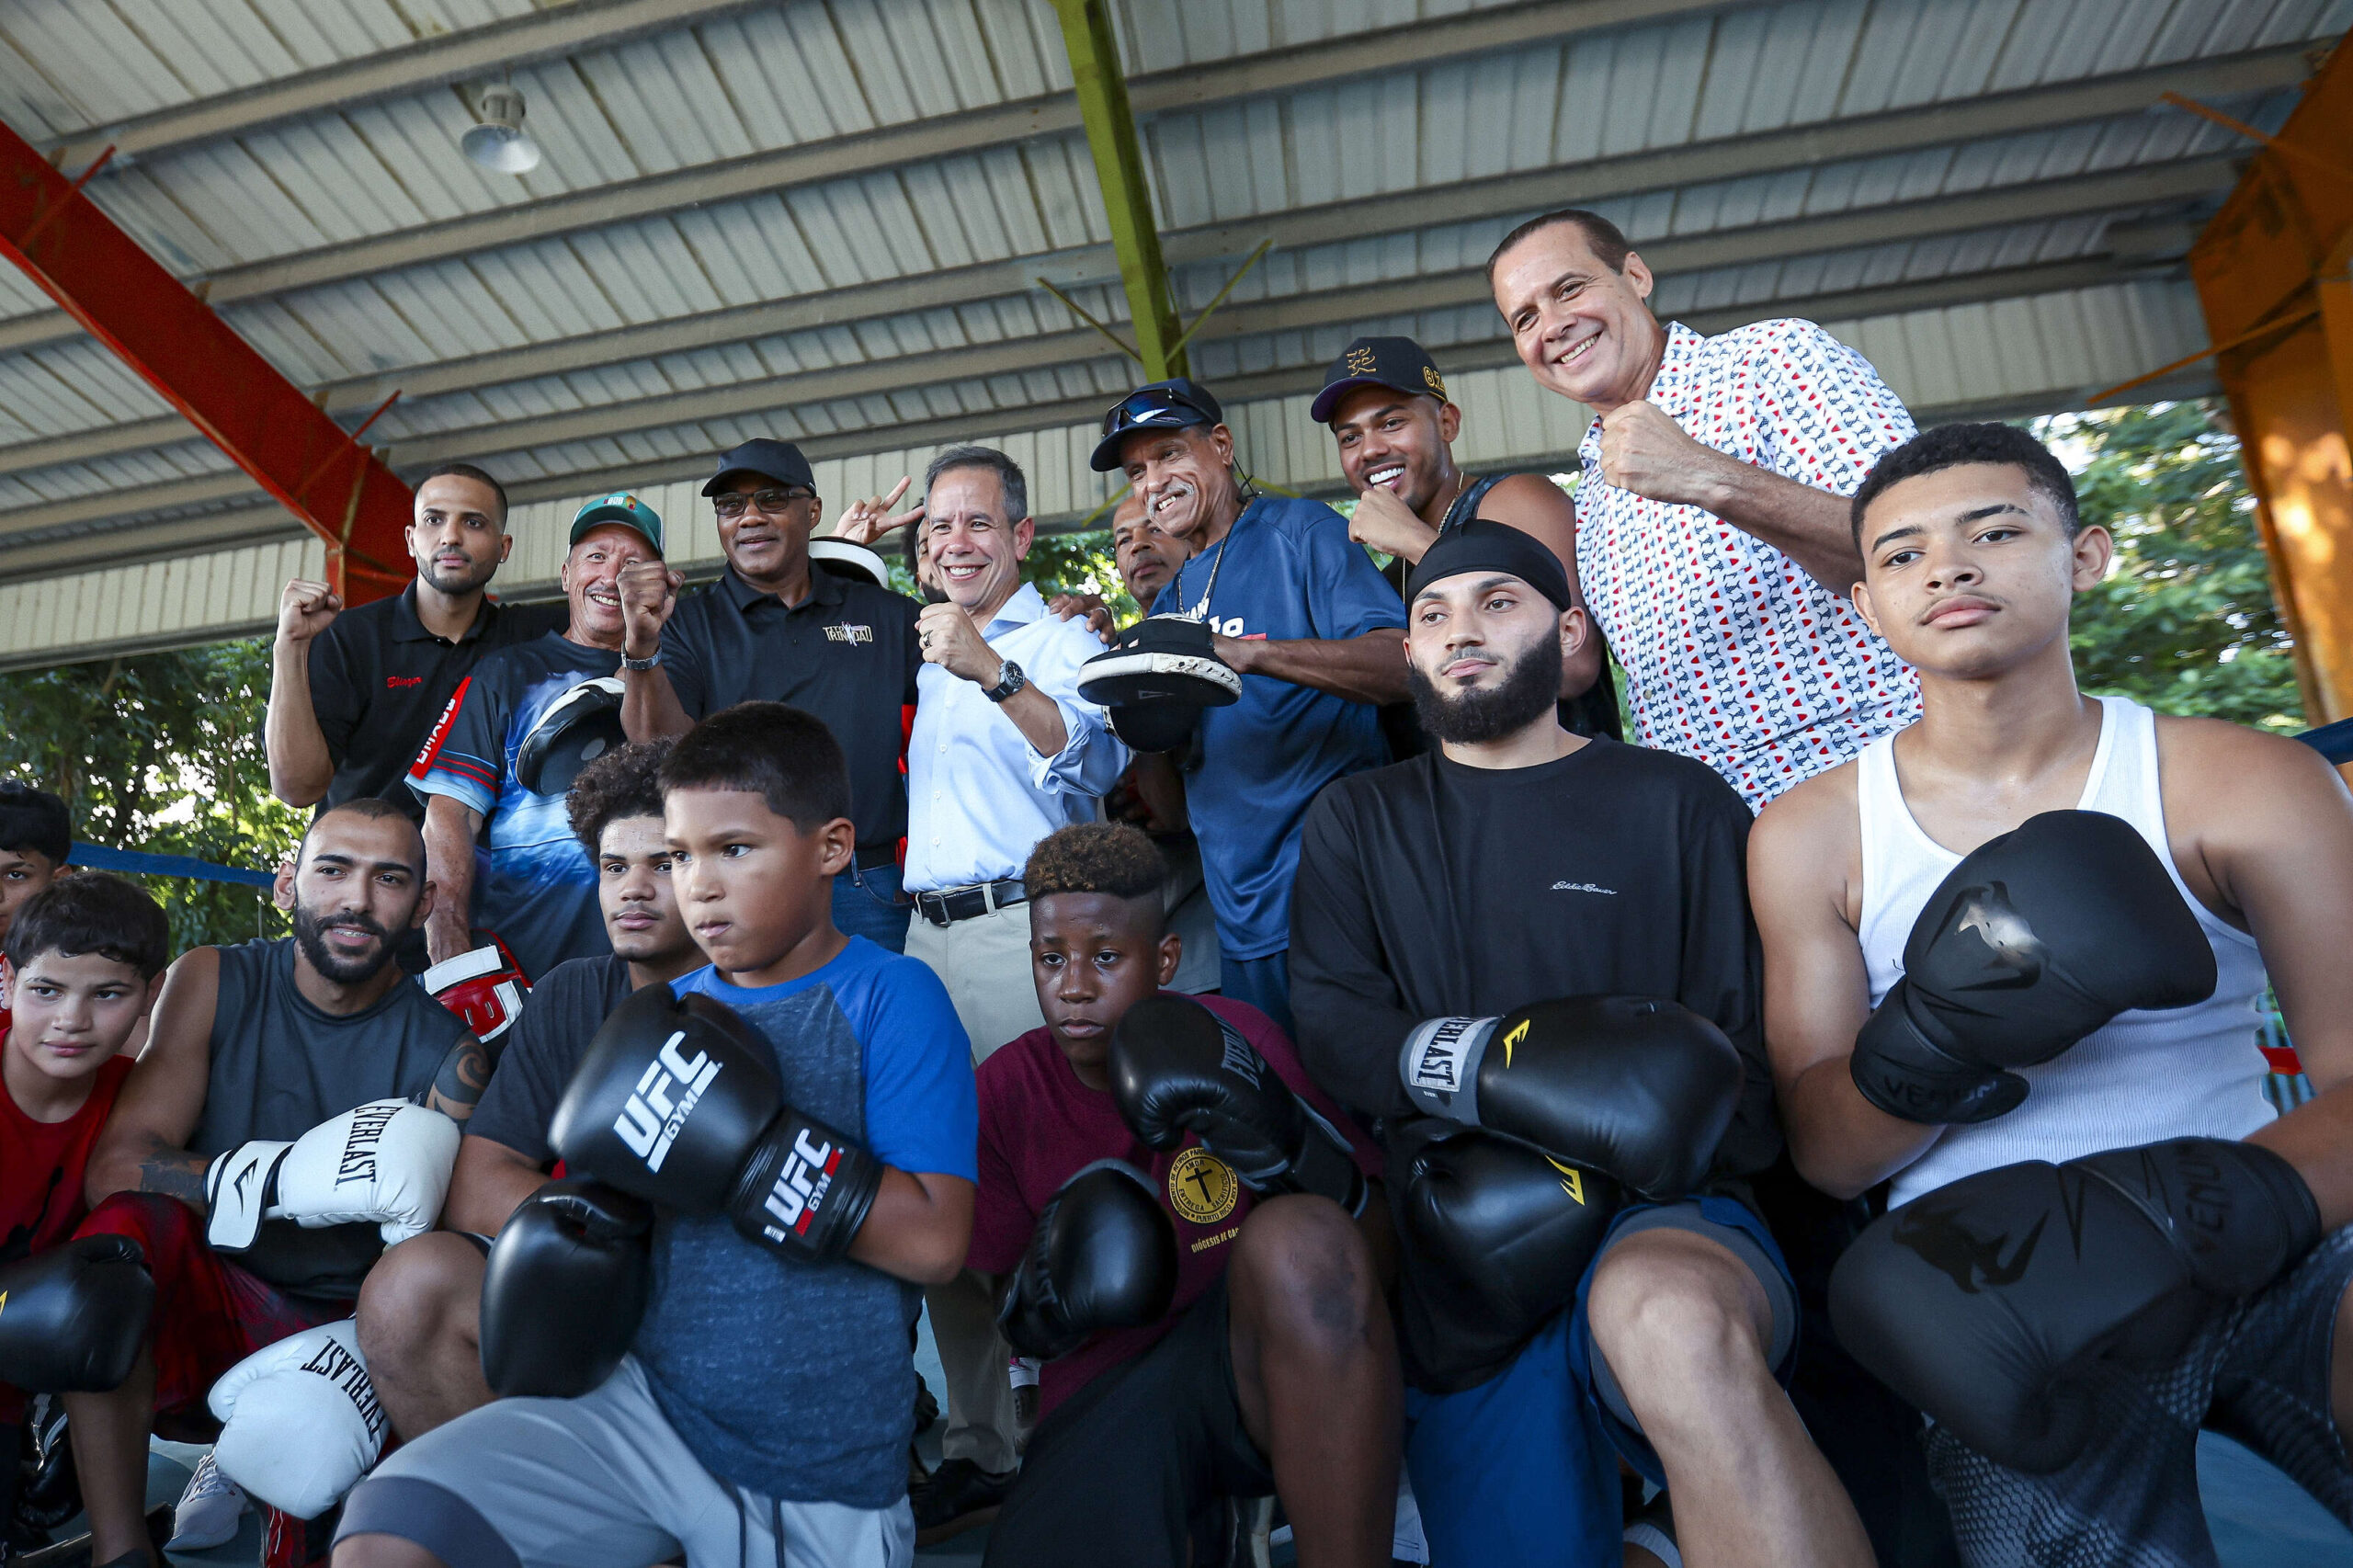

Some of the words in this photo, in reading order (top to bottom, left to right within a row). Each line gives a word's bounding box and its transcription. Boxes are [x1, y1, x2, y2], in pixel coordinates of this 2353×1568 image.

[1416, 1017, 1476, 1086] ERLAST
[613, 1030, 708, 1158] UFC
[664, 1088, 699, 1142] GYM
[335, 1106, 405, 1187] EVERLAST
[765, 1128, 831, 1226] UFC
[807, 1171, 832, 1212] GYM
[300, 1338, 386, 1444] EVERLAST
